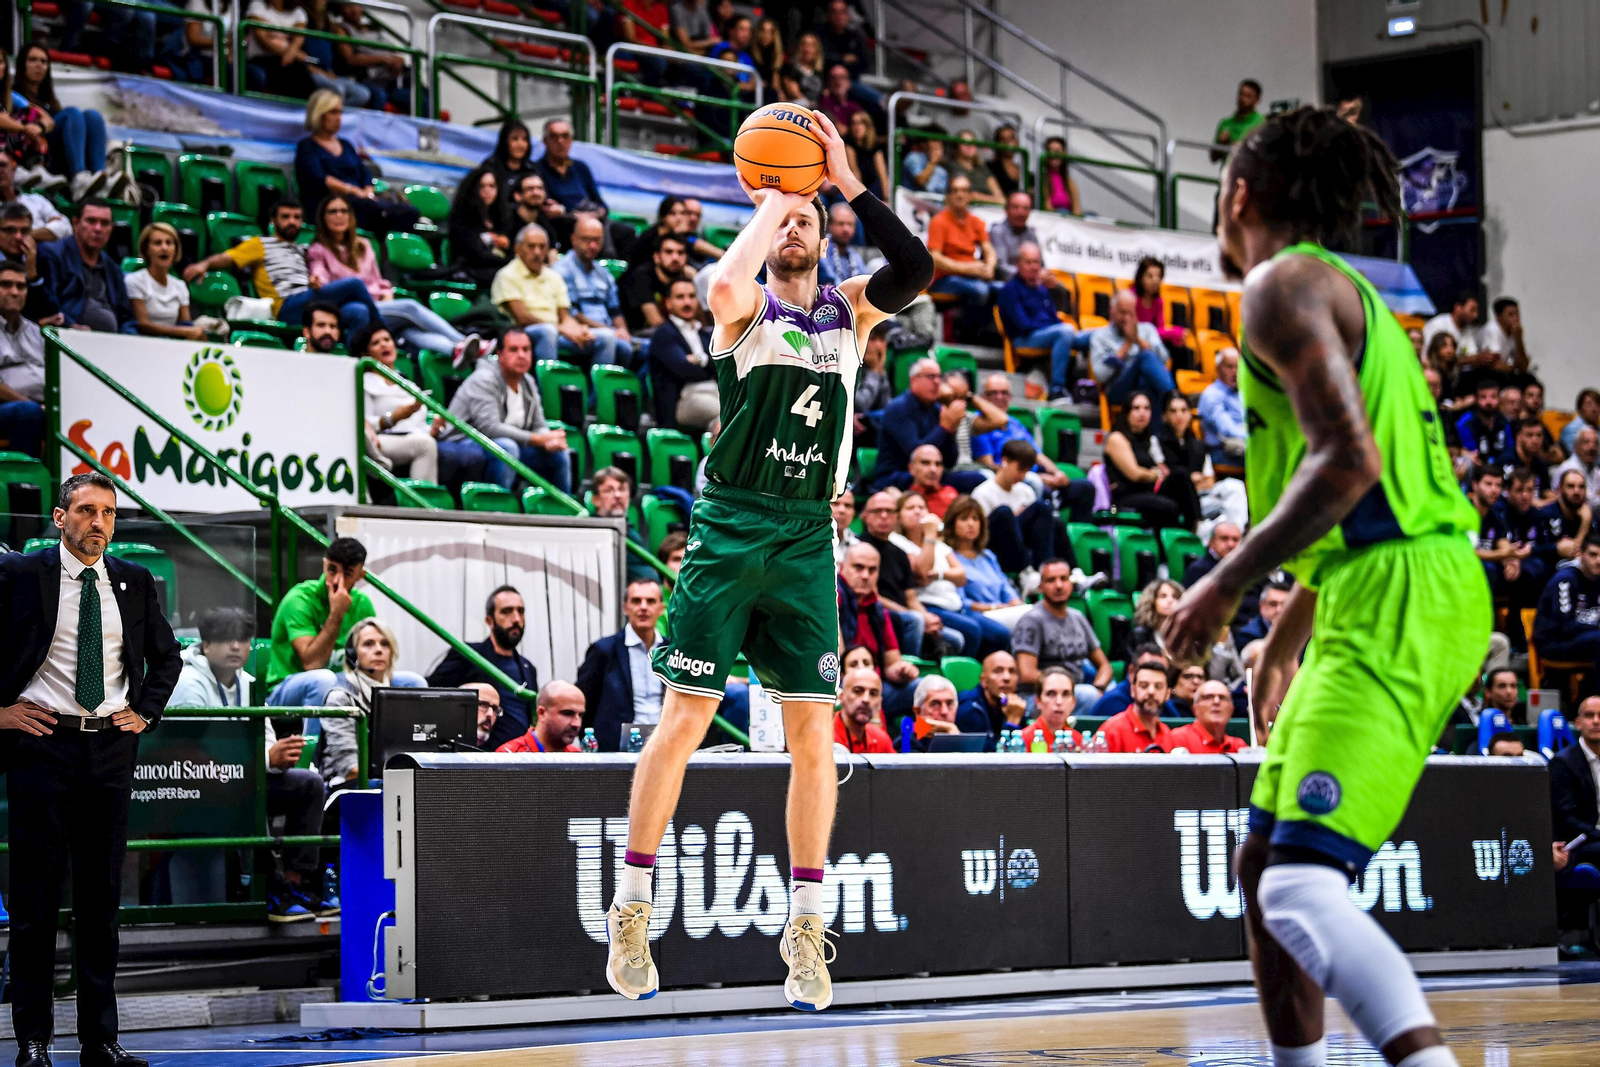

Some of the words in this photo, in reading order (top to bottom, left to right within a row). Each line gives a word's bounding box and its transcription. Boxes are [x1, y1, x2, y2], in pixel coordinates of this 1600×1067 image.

[752, 109, 811, 131] Wilso
[760, 173, 781, 184] FIBA
[790, 384, 824, 428] 4
[765, 437, 827, 466] Andalía
[759, 709, 767, 721] 3
[758, 729, 766, 742] 2
[133, 763, 168, 780] anco
[168, 760, 181, 780] di
[182, 760, 244, 784] Sardegna
[157, 786, 178, 800] BPER
[177, 786, 201, 800] Banca
